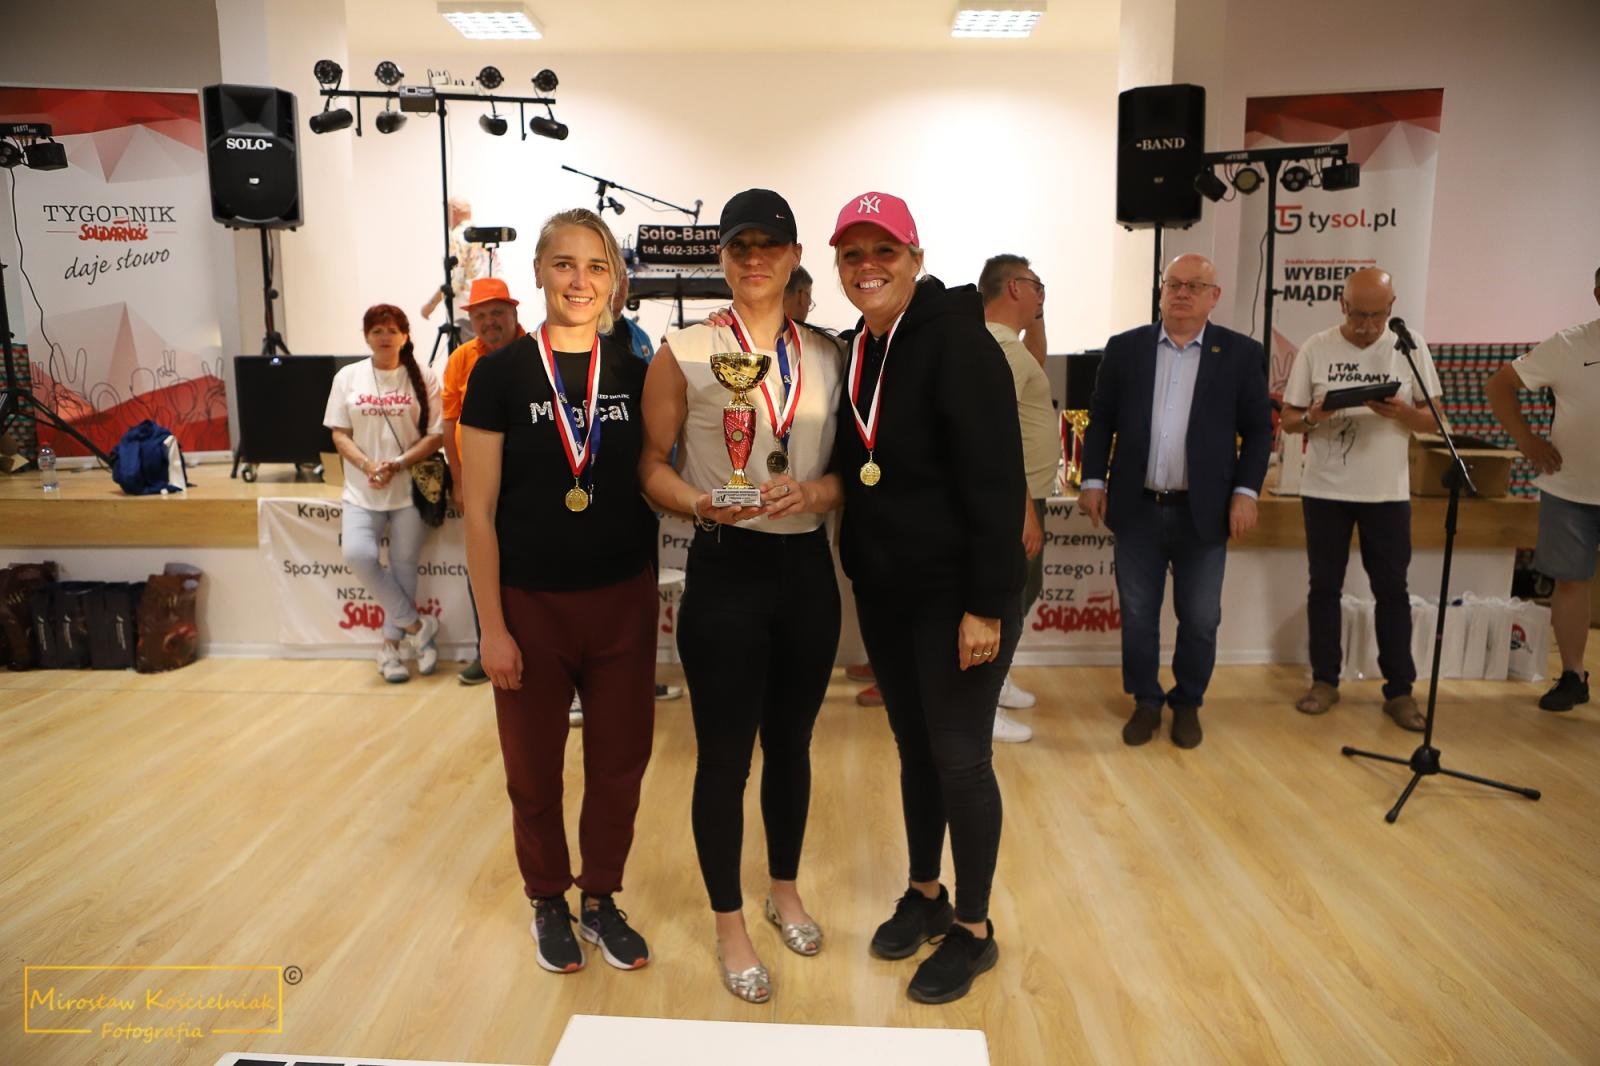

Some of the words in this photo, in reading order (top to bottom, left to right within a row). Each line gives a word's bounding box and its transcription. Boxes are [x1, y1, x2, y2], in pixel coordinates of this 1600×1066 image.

[226, 138, 273, 150] SOLO-
[1136, 137, 1185, 150] -BAND
[43, 205, 176, 222] TYGODNIK
[1308, 208, 1396, 232] tysol.pl
[642, 245, 661, 255] tel.
[663, 245, 719, 255] 602-353-3
[64, 256, 112, 285] daje
[116, 248, 170, 271] słowo
[1285, 267, 1357, 280] WYBIER
[1283, 285, 1344, 306] MĄDR
[1336, 363, 1360, 373] TAK
[1328, 373, 1390, 384] WYGRAMY
[298, 504, 343, 521] Krajo
[1045, 504, 1073, 519] wy
[663, 535, 689, 548] Prz
[1044, 532, 1115, 550] Przemys
[1044, 562, 1094, 579] czego
[337, 588, 373, 600] NSZ
